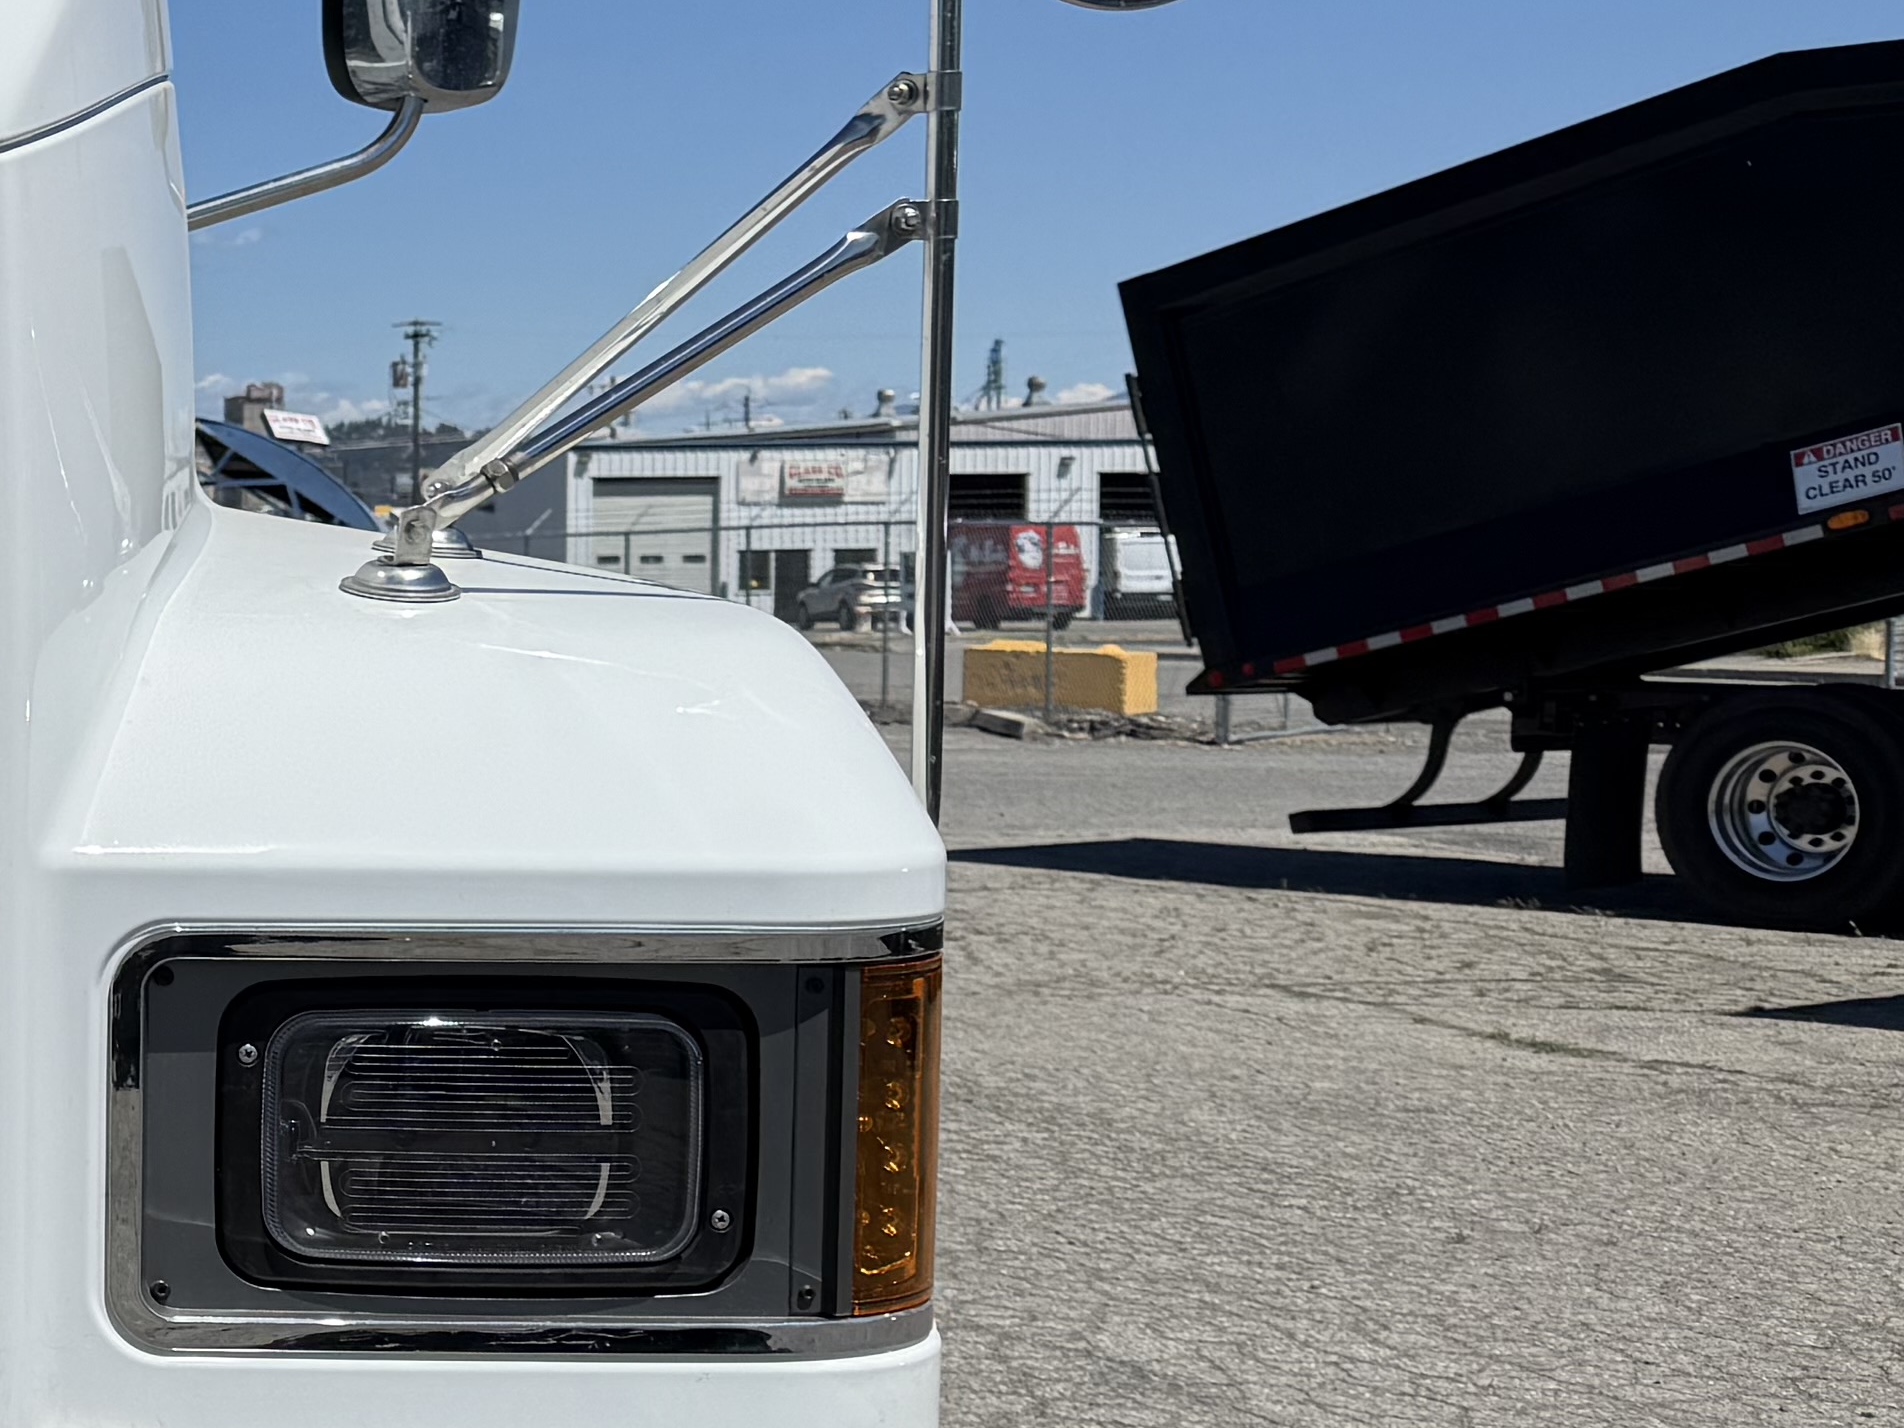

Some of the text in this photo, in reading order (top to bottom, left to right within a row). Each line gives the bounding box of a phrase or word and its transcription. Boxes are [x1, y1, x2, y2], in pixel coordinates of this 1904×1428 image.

[1823, 430, 1892, 459] DANGER
[1817, 452, 1879, 478] STAND
[1805, 466, 1896, 500] CLEAR 50'
